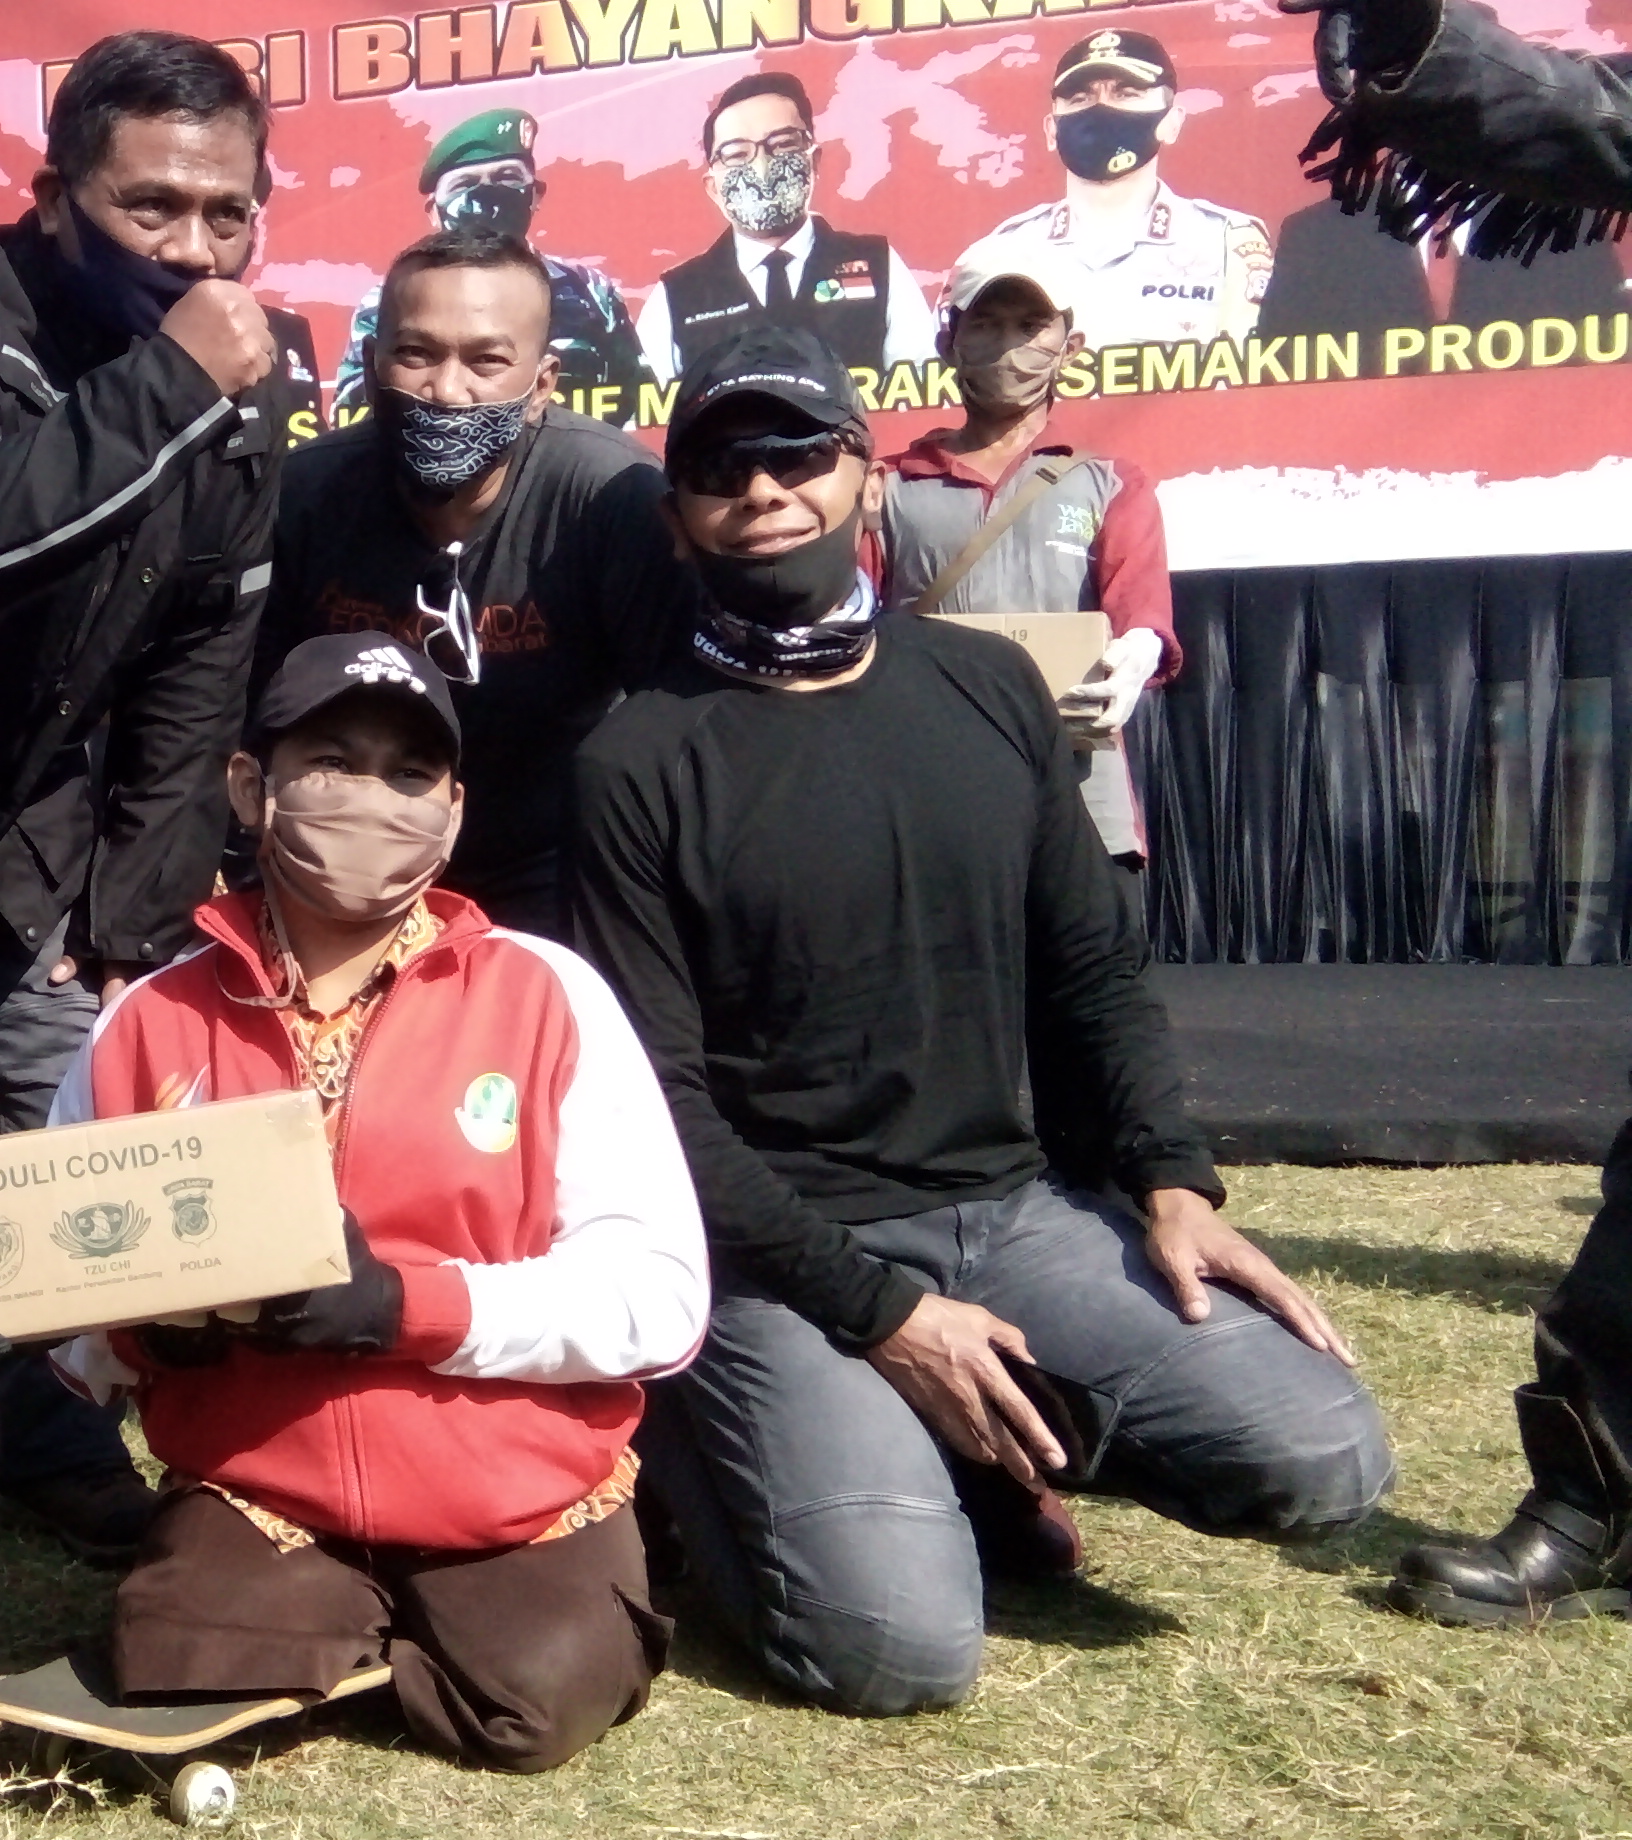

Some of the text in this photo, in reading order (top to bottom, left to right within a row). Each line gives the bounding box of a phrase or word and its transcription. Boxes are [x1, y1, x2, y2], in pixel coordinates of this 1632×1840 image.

[1141, 284, 1215, 301] POLRI
[1056, 332, 1360, 397] SEMAKIN
[1385, 313, 1630, 376] PRODU
[66, 1136, 203, 1179] COVID-19
[84, 1260, 131, 1275] TZU CHI
[179, 1257, 222, 1272] POLDA
